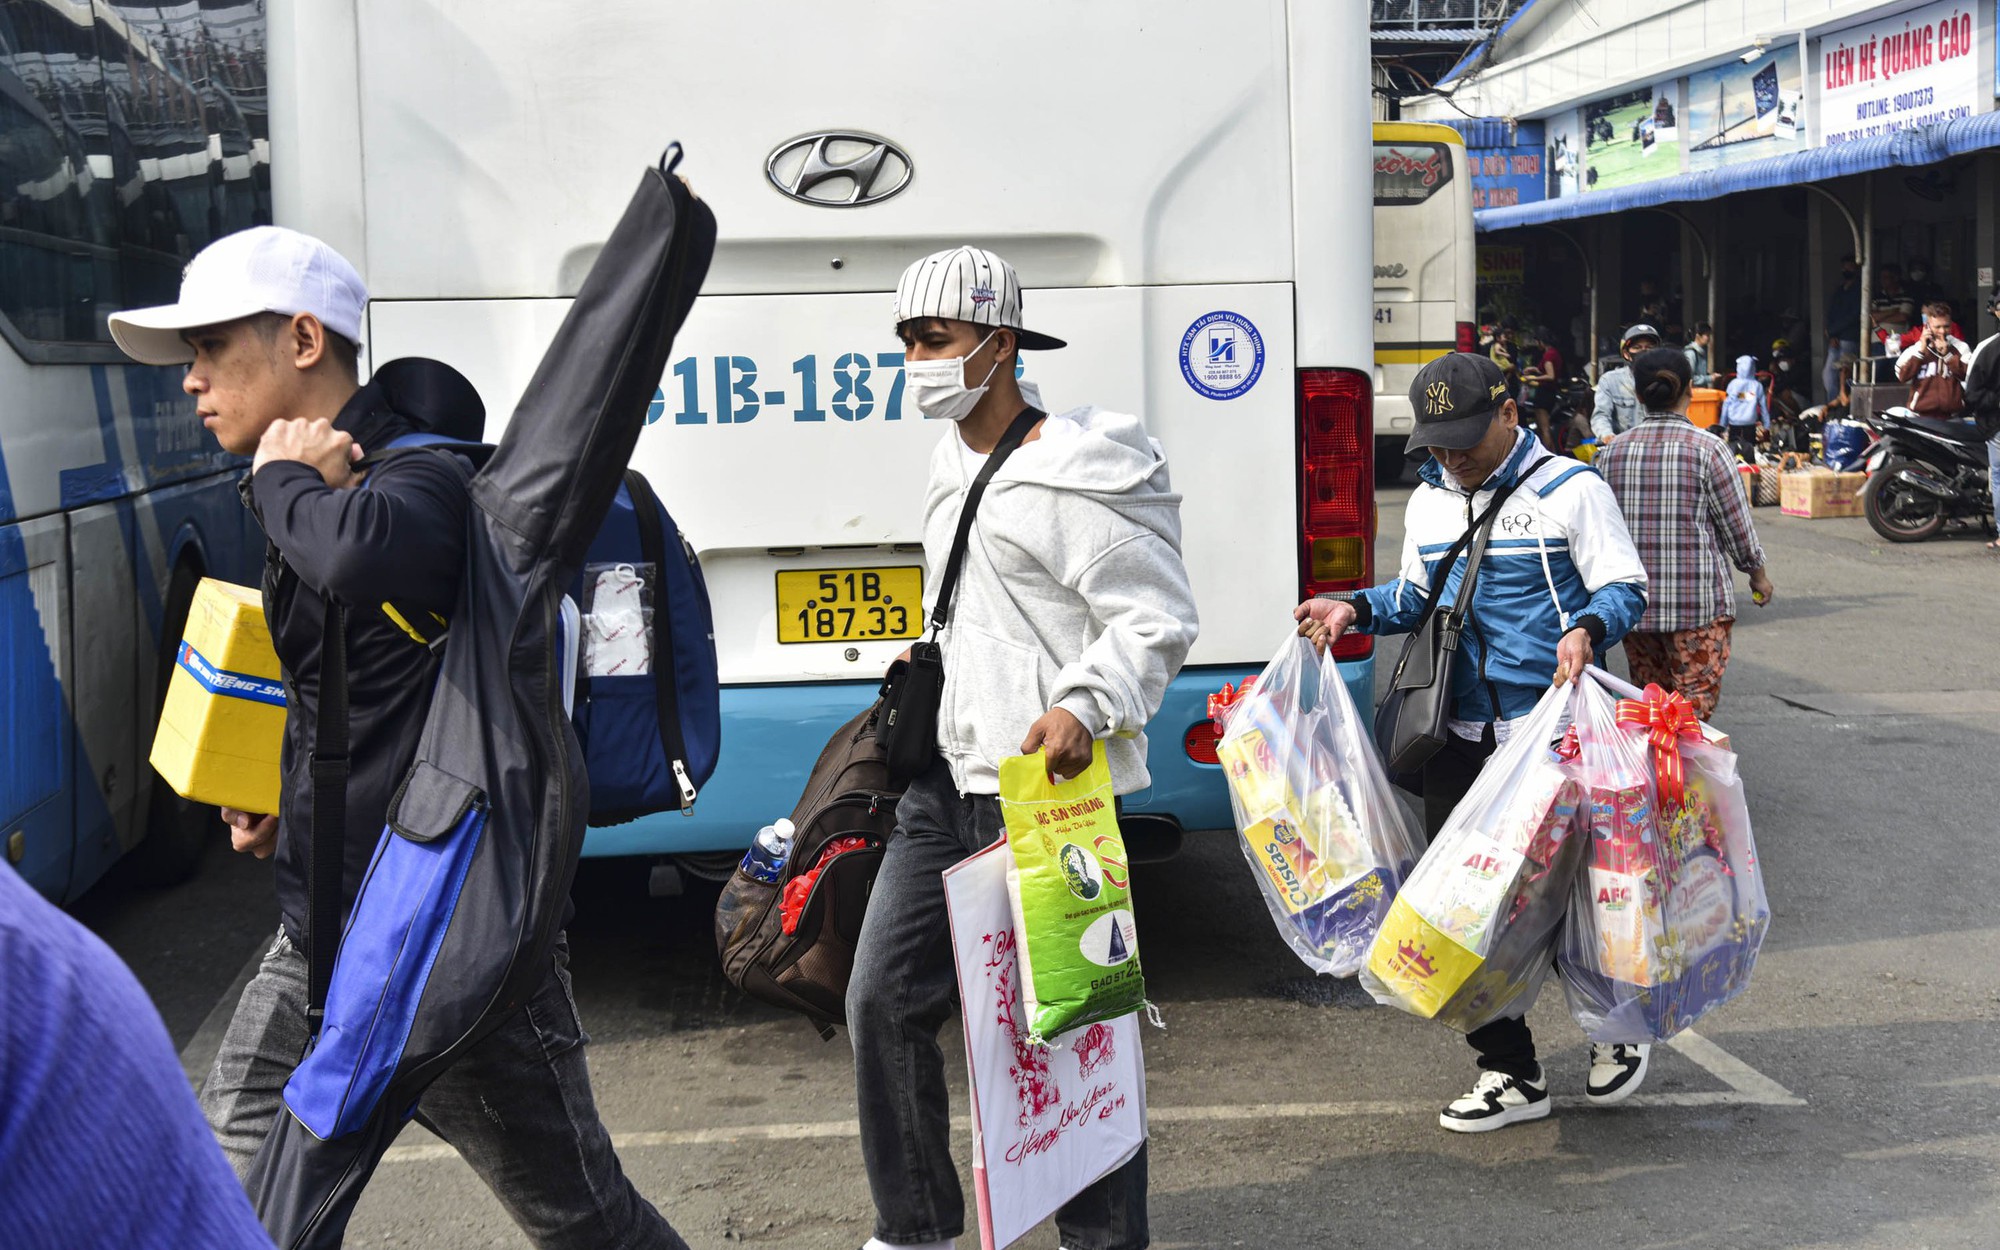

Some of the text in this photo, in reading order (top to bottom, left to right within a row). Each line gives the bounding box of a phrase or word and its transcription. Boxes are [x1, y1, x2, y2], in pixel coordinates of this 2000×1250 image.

[1826, 9, 1971, 90] LIÊN HỆ QUẢNG CÁO
[1856, 86, 1934, 120] HOTLINE: 19007373
[819, 572, 881, 603] 51B
[798, 606, 907, 638] 187.33
[1264, 842, 1309, 907] Custas
